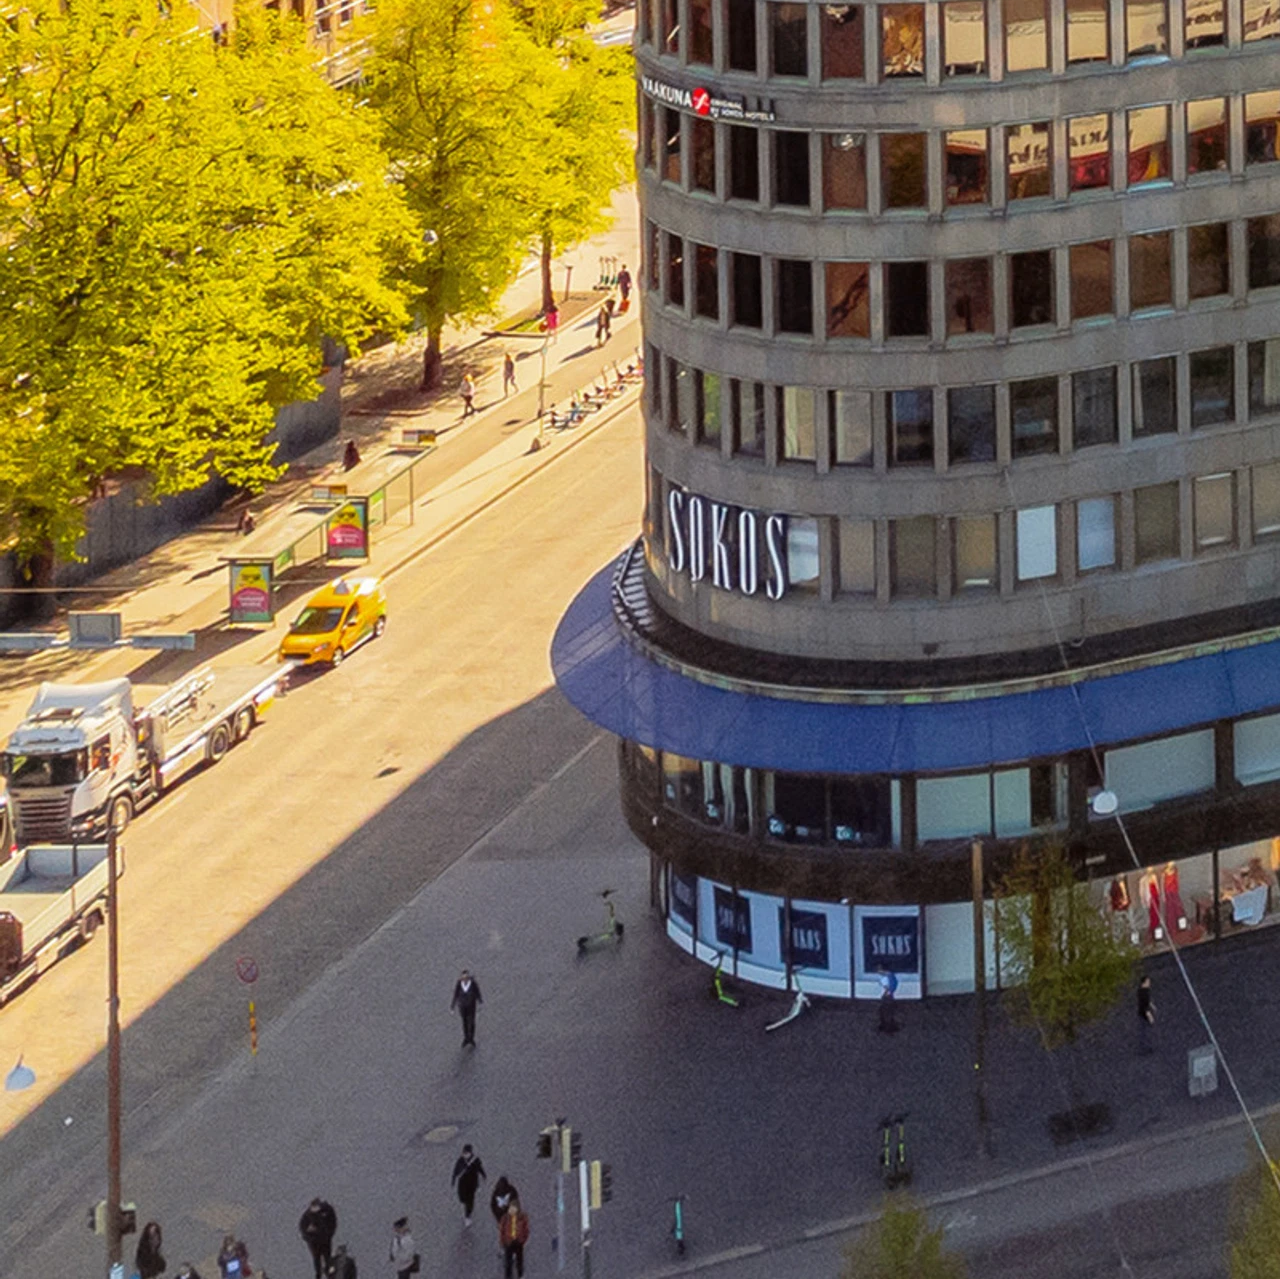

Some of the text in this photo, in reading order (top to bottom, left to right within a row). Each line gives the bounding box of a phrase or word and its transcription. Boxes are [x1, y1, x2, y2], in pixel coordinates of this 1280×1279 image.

[642, 75, 693, 108] VAAKUNA
[669, 489, 784, 600] SOKOS
[872, 934, 911, 955] SOKOS
